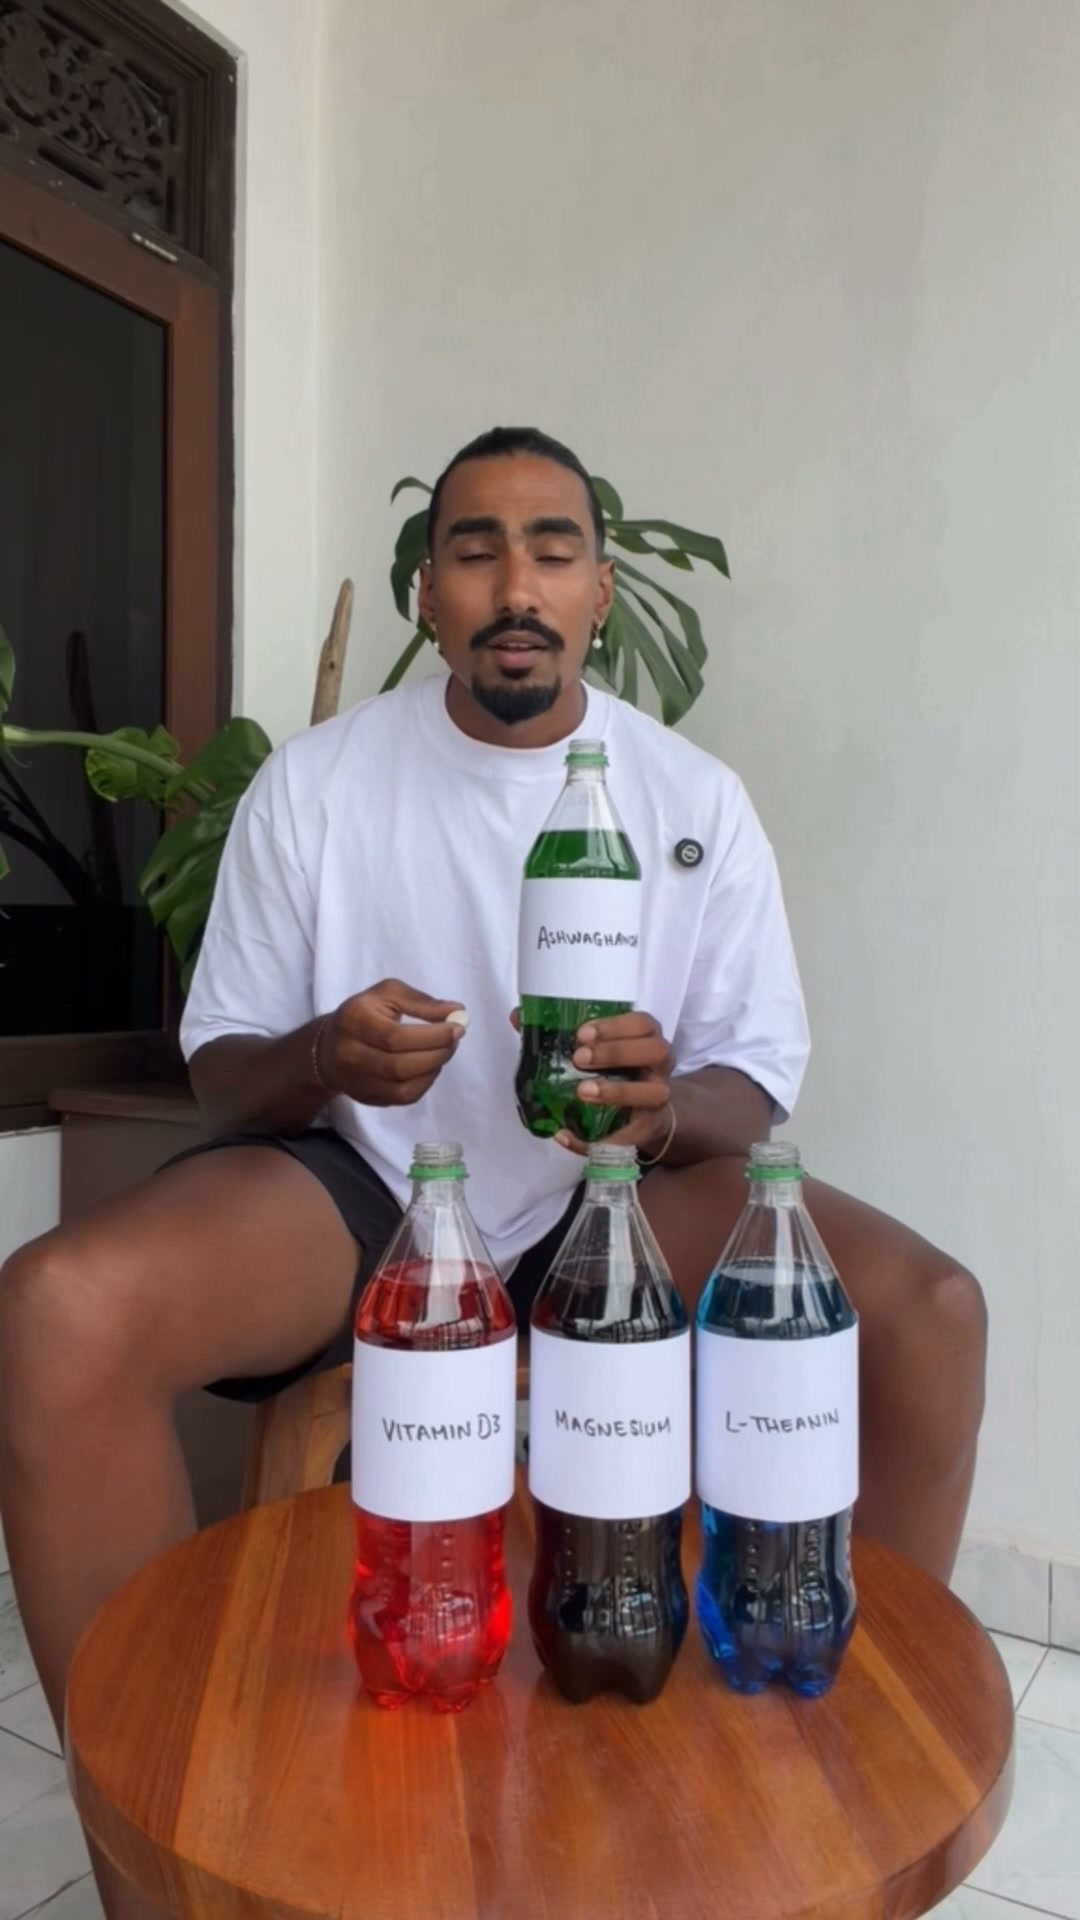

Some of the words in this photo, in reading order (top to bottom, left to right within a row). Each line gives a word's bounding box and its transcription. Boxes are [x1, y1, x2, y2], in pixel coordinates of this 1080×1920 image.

[382, 1417, 471, 1442] VITAMIN
[477, 1413, 501, 1440] D3
[555, 1408, 671, 1437] MAGNESIUM
[725, 1408, 839, 1434] L-THEANIN
